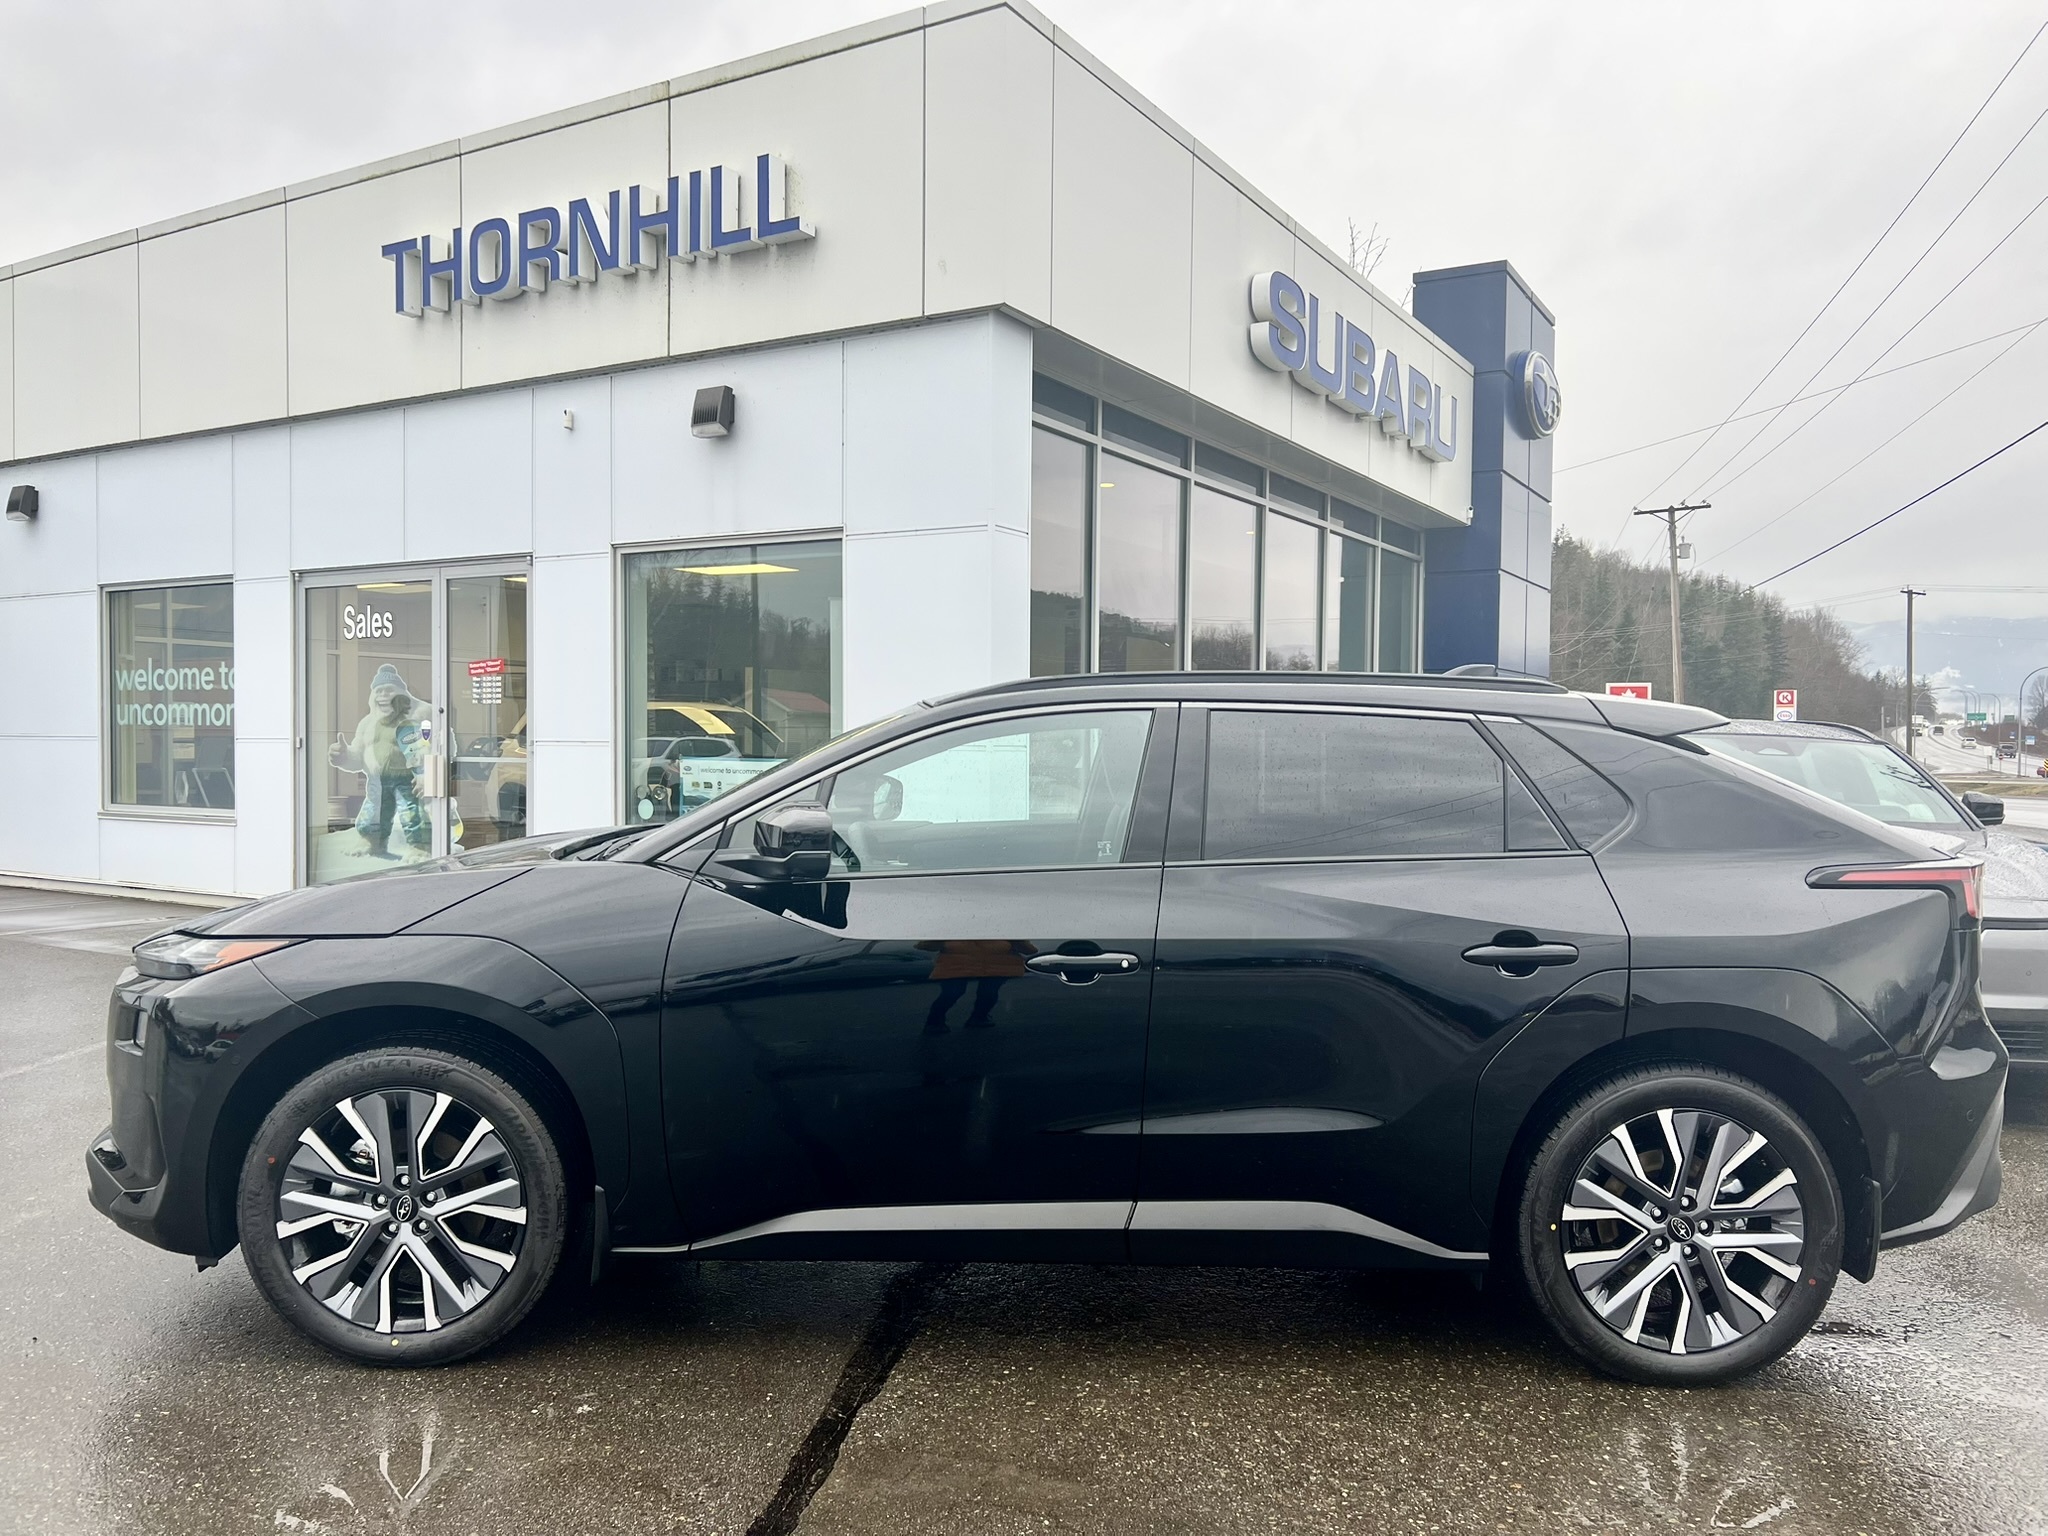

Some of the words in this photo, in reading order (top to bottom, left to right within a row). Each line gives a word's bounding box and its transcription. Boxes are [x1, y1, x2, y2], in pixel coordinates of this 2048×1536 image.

[381, 153, 816, 318] THORNHILL
[1250, 270, 1458, 463] SUBARU
[343, 604, 393, 640] Sales
[115, 658, 215, 691] welcome
[700, 765, 724, 774] welcome
